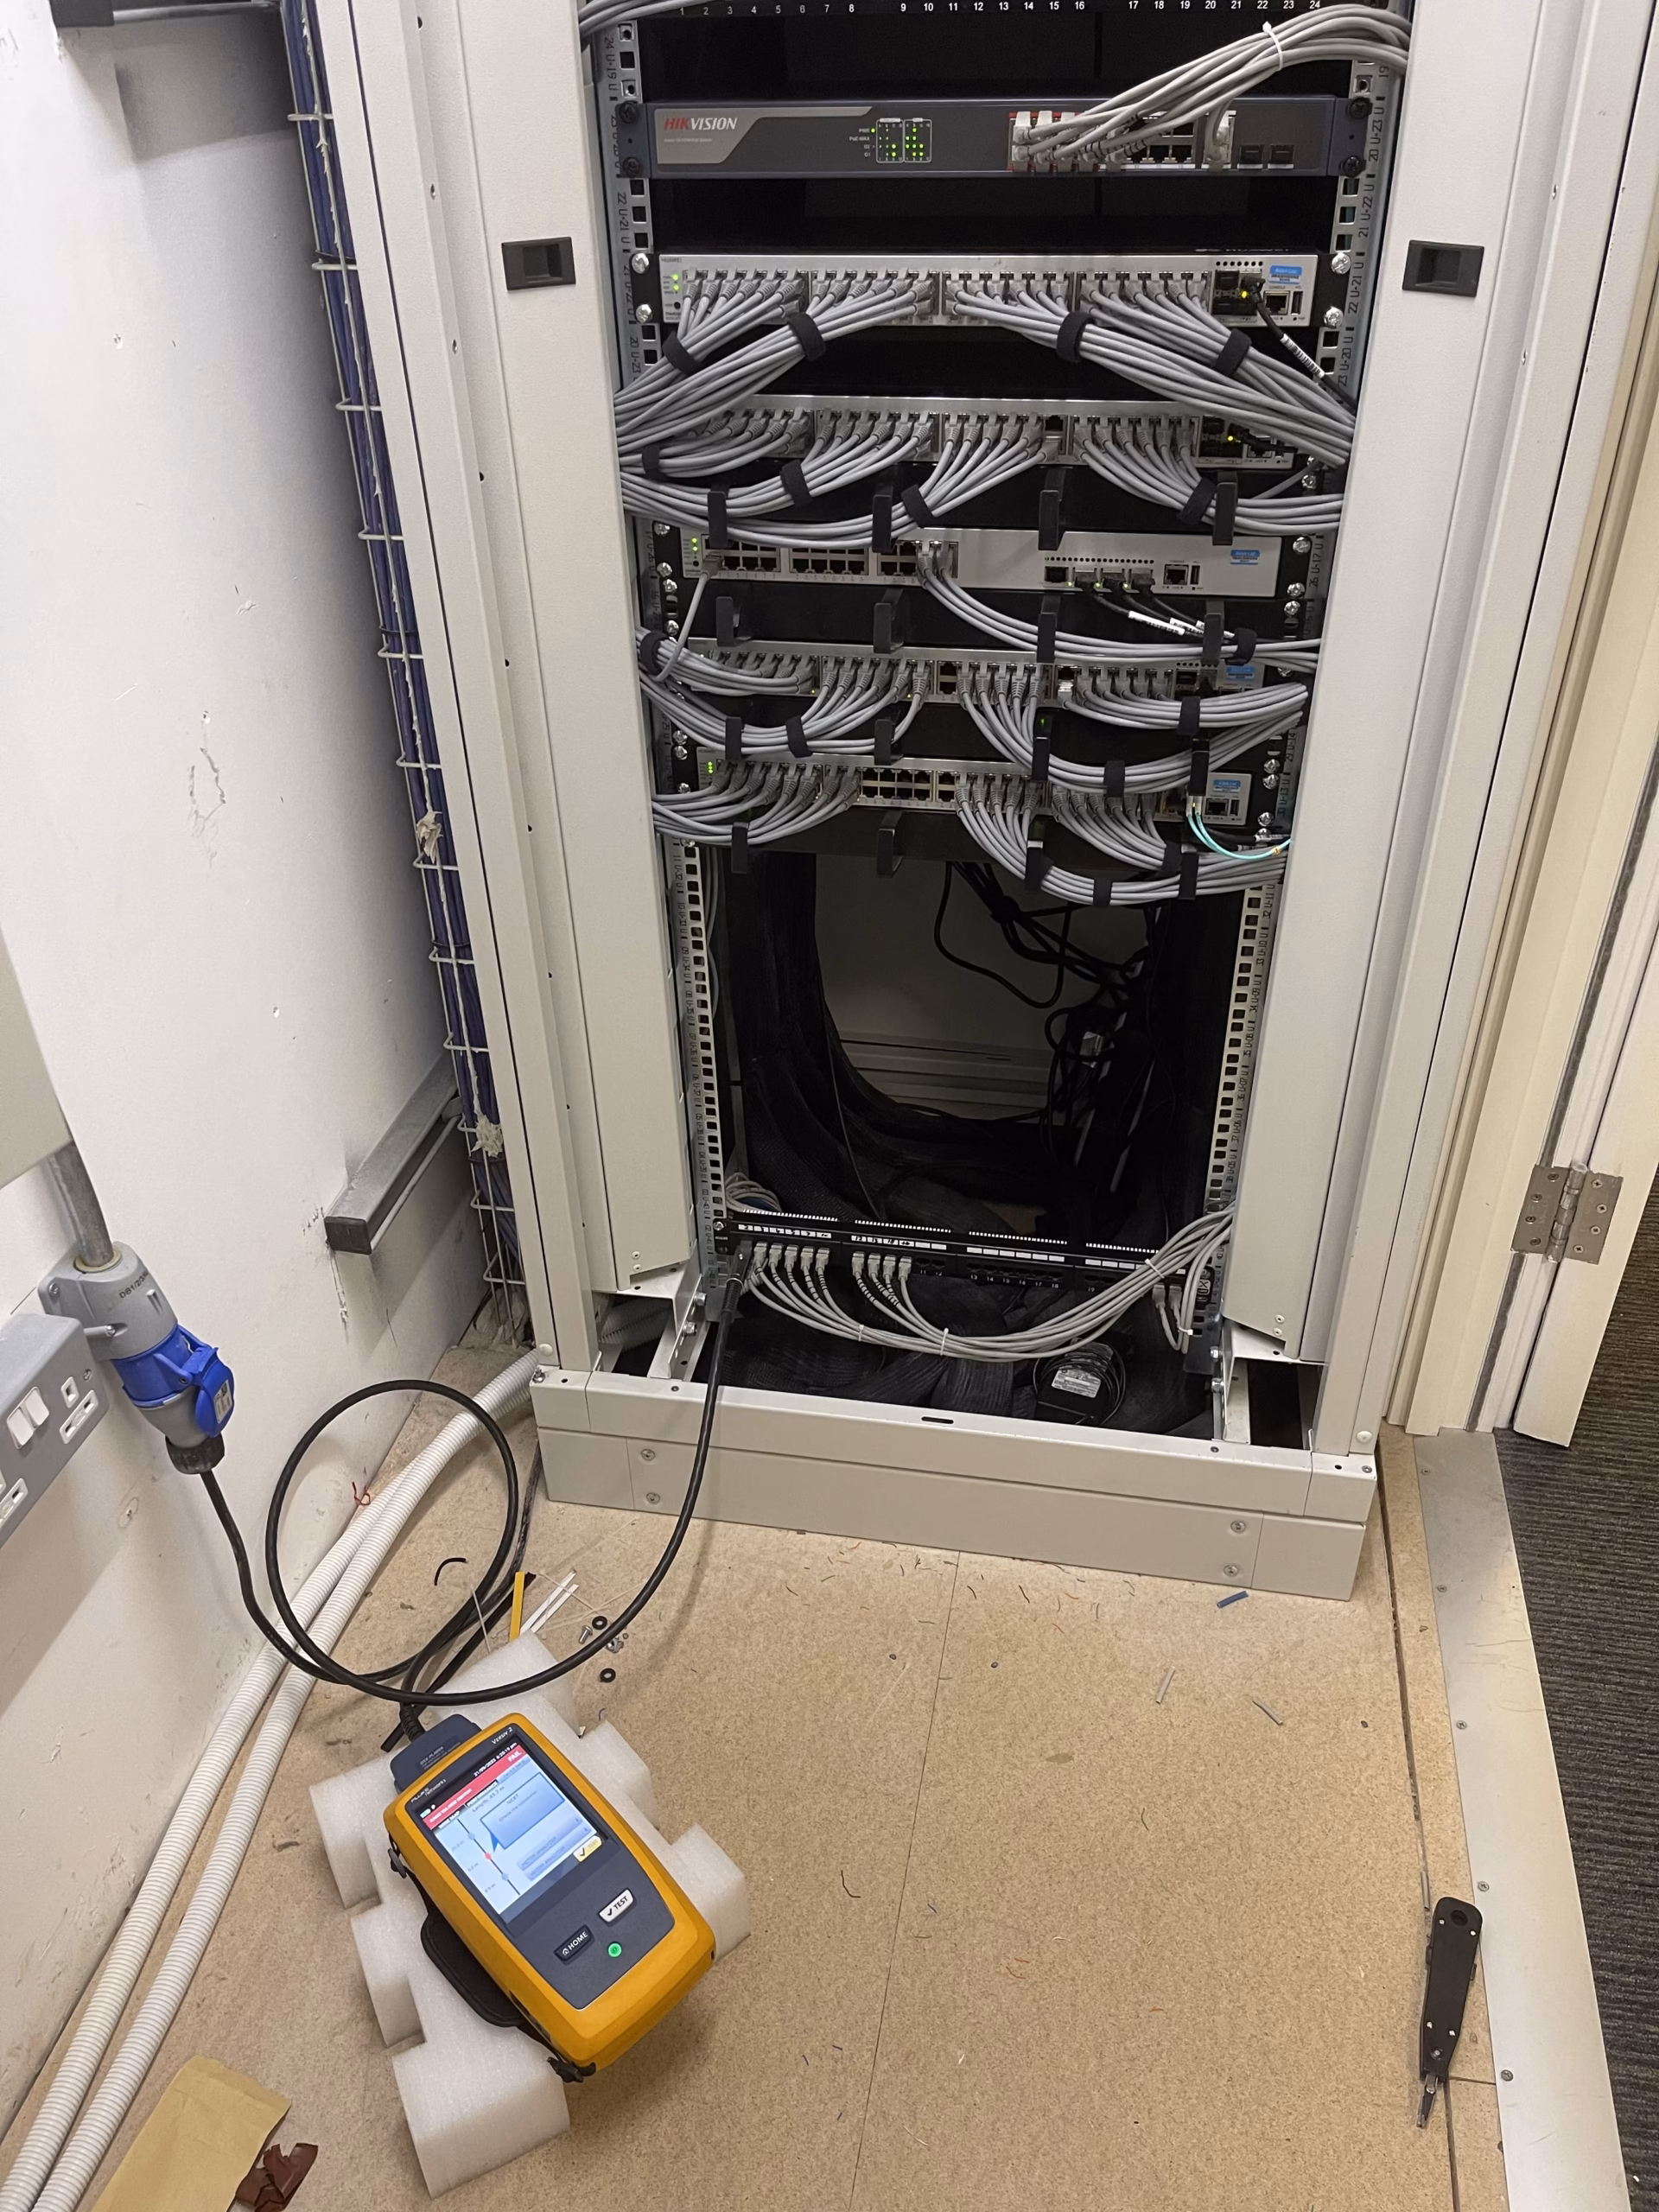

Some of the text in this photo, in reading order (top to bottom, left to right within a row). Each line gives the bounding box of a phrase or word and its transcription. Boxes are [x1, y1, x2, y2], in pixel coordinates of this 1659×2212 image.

[680, 7, 685, 16] 1
[703, 7, 709, 16] 2
[751, 6, 757, 15] 4
[776, 5, 781, 14] 5
[799, 5, 805, 14] 6
[823, 4, 830, 13] 7
[849, 3, 855, 13] 8
[900, 3, 906, 12] 9
[924, 3, 934, 12] 10
[949, 3, 958, 11] 11
[974, 3, 984, 11] 12
[999, 2, 1009, 11] 13
[1024, 2, 1034, 10] 14
[1049, 2, 1059, 10] 15
[1074, 1, 1085, 10] 16
[1128, 1, 1139, 10] 17
[1154, 1, 1165, 10] 18
[1179, 1, 1191, 10] 19
[1205, 1, 1216, 10] 20
[1230, 1, 1242, 10] 21
[1256, 1, 1268, 10] 22
[1282, 1, 1294, 10] 23
[1309, 1, 1320, 10] 24
[605, 37, 614, 49] 24
[1378, 66, 1390, 78] 19
[664, 117, 738, 130] HIKVISION
[1368, 149, 1379, 162] 20
[618, 192, 626, 205] 22
[1358, 226, 1370, 238] 21
[1348, 302, 1358, 314] 22
[630, 336, 639, 347] 20
[506, 1749, 522, 1763] FAIL
[465, 1780, 499, 1807] PERFORMANCE
[505, 1793, 519, 1805] NEXT
[613, 1895, 628, 1910] TEST
[567, 1930, 588, 1950] HOME
